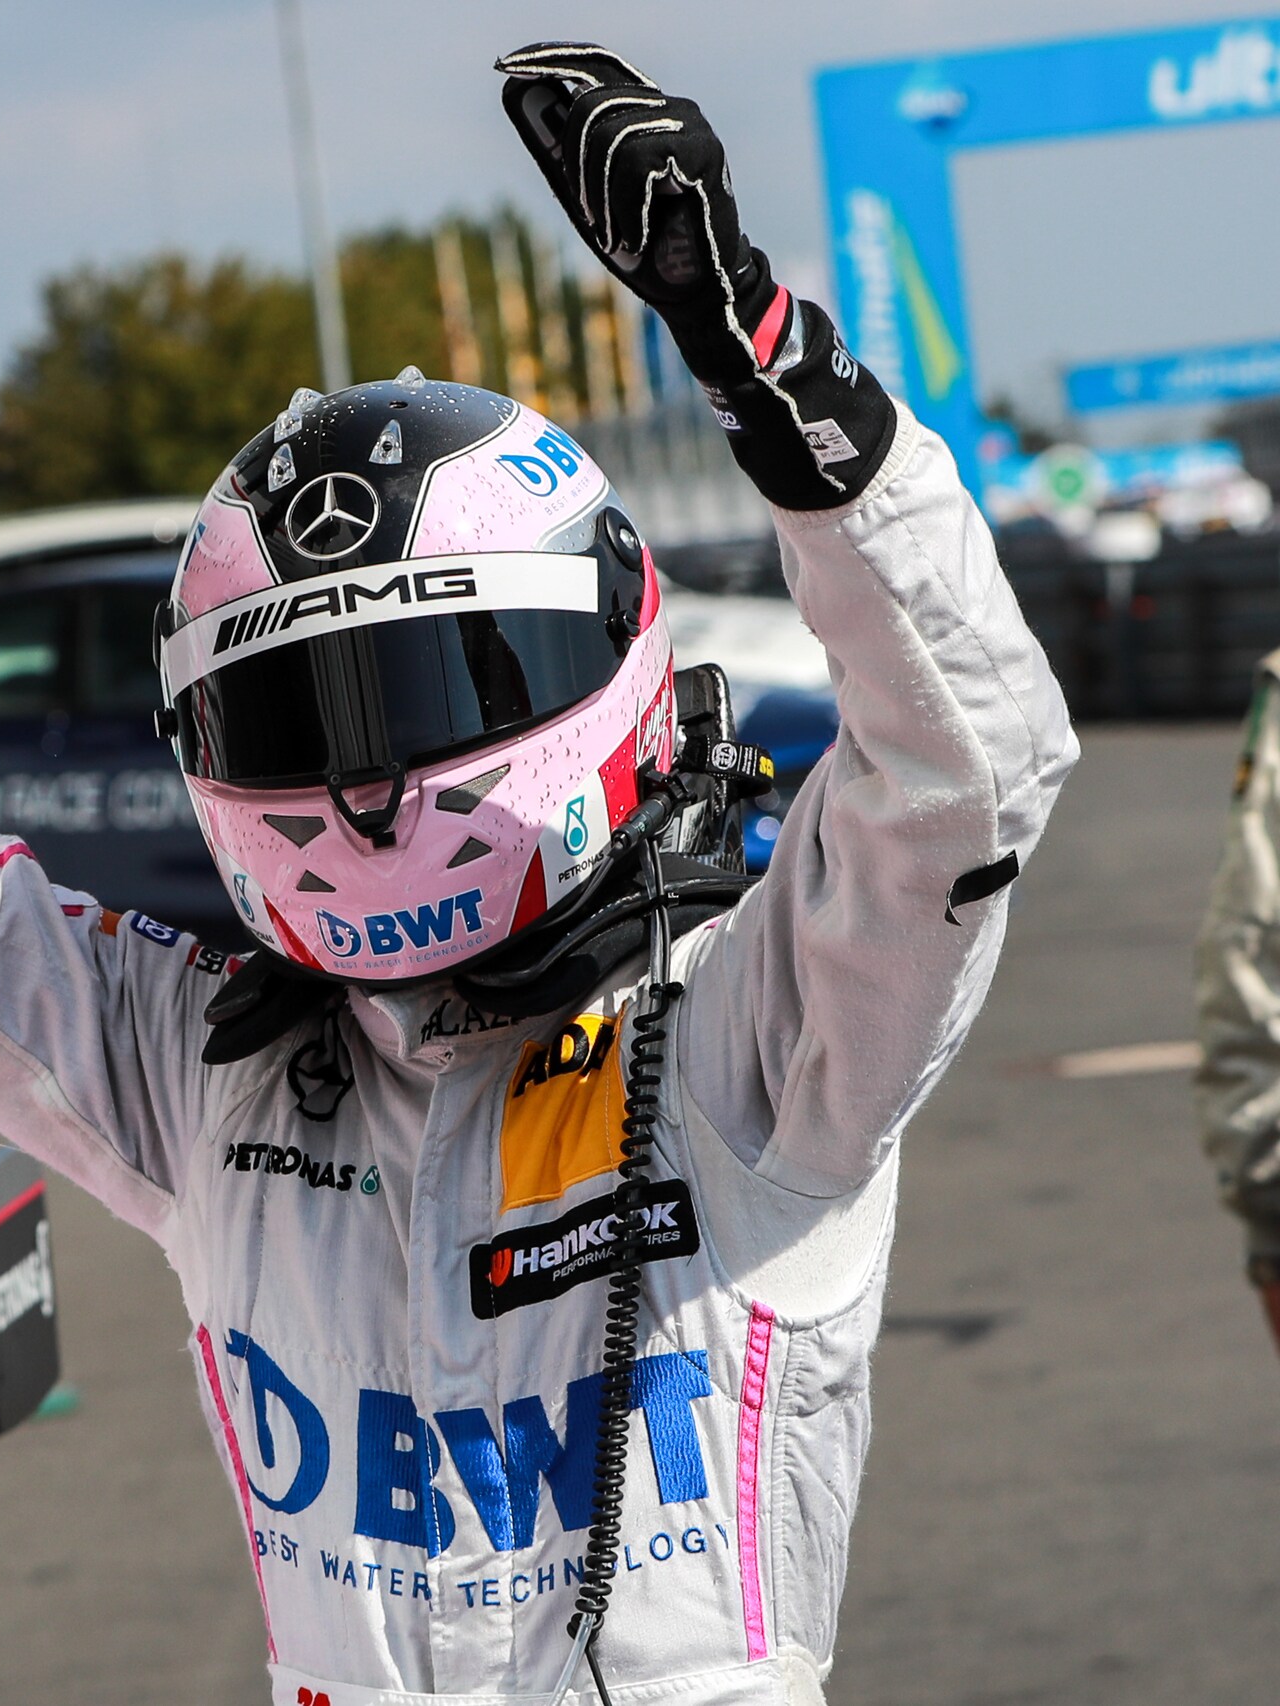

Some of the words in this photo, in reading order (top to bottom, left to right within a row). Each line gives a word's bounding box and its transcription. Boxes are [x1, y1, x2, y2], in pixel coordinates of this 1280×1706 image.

[533, 422, 584, 479] BW
[279, 567, 478, 632] AMG
[558, 851, 605, 884] PETRONAS
[362, 887, 485, 956] BWT
[364, 959, 402, 969] WATER
[408, 933, 491, 963] TECHNOLOGY
[511, 1020, 617, 1099] ADA
[222, 1141, 358, 1192] PETRONAS
[552, 1245, 617, 1282] PERFORMA
[354, 1349, 714, 1559] BWT
[253, 1530, 299, 1568] BEST
[320, 1549, 434, 1612] WATER
[457, 1523, 731, 1610] TECHNLOGY
